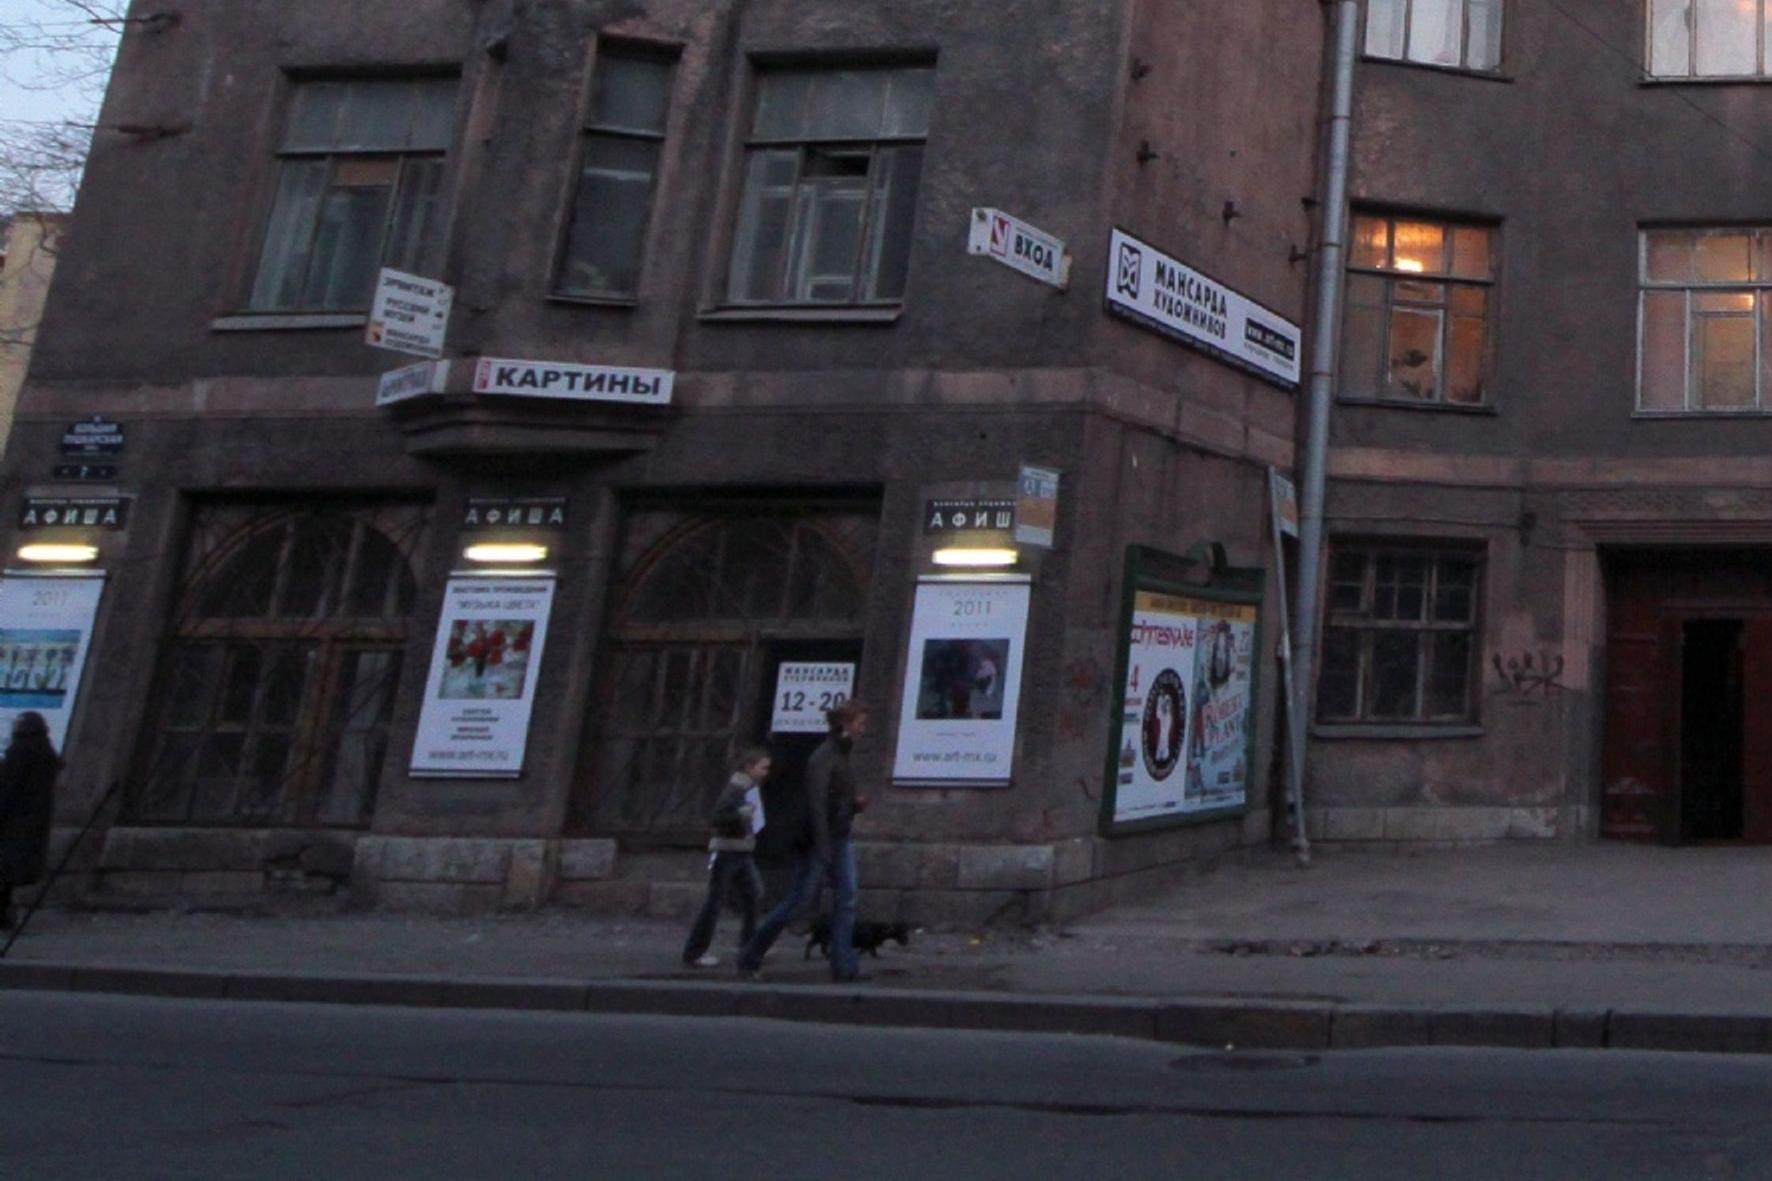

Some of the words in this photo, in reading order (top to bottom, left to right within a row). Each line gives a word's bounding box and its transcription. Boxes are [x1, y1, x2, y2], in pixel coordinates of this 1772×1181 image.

[1014, 233, 1054, 272] ВХОД
[1155, 259, 1227, 318] МАНСАРДА
[1153, 288, 1226, 340] ХУДОЖНИКОВ
[496, 366, 662, 396] КАРТИНЫ
[24, 509, 117, 524] АФИША
[464, 508, 563, 524] АФИША
[930, 511, 1012, 528] АФИШ
[953, 600, 991, 616] 2011
[913, 751, 998, 762] www.art-mx.ru
